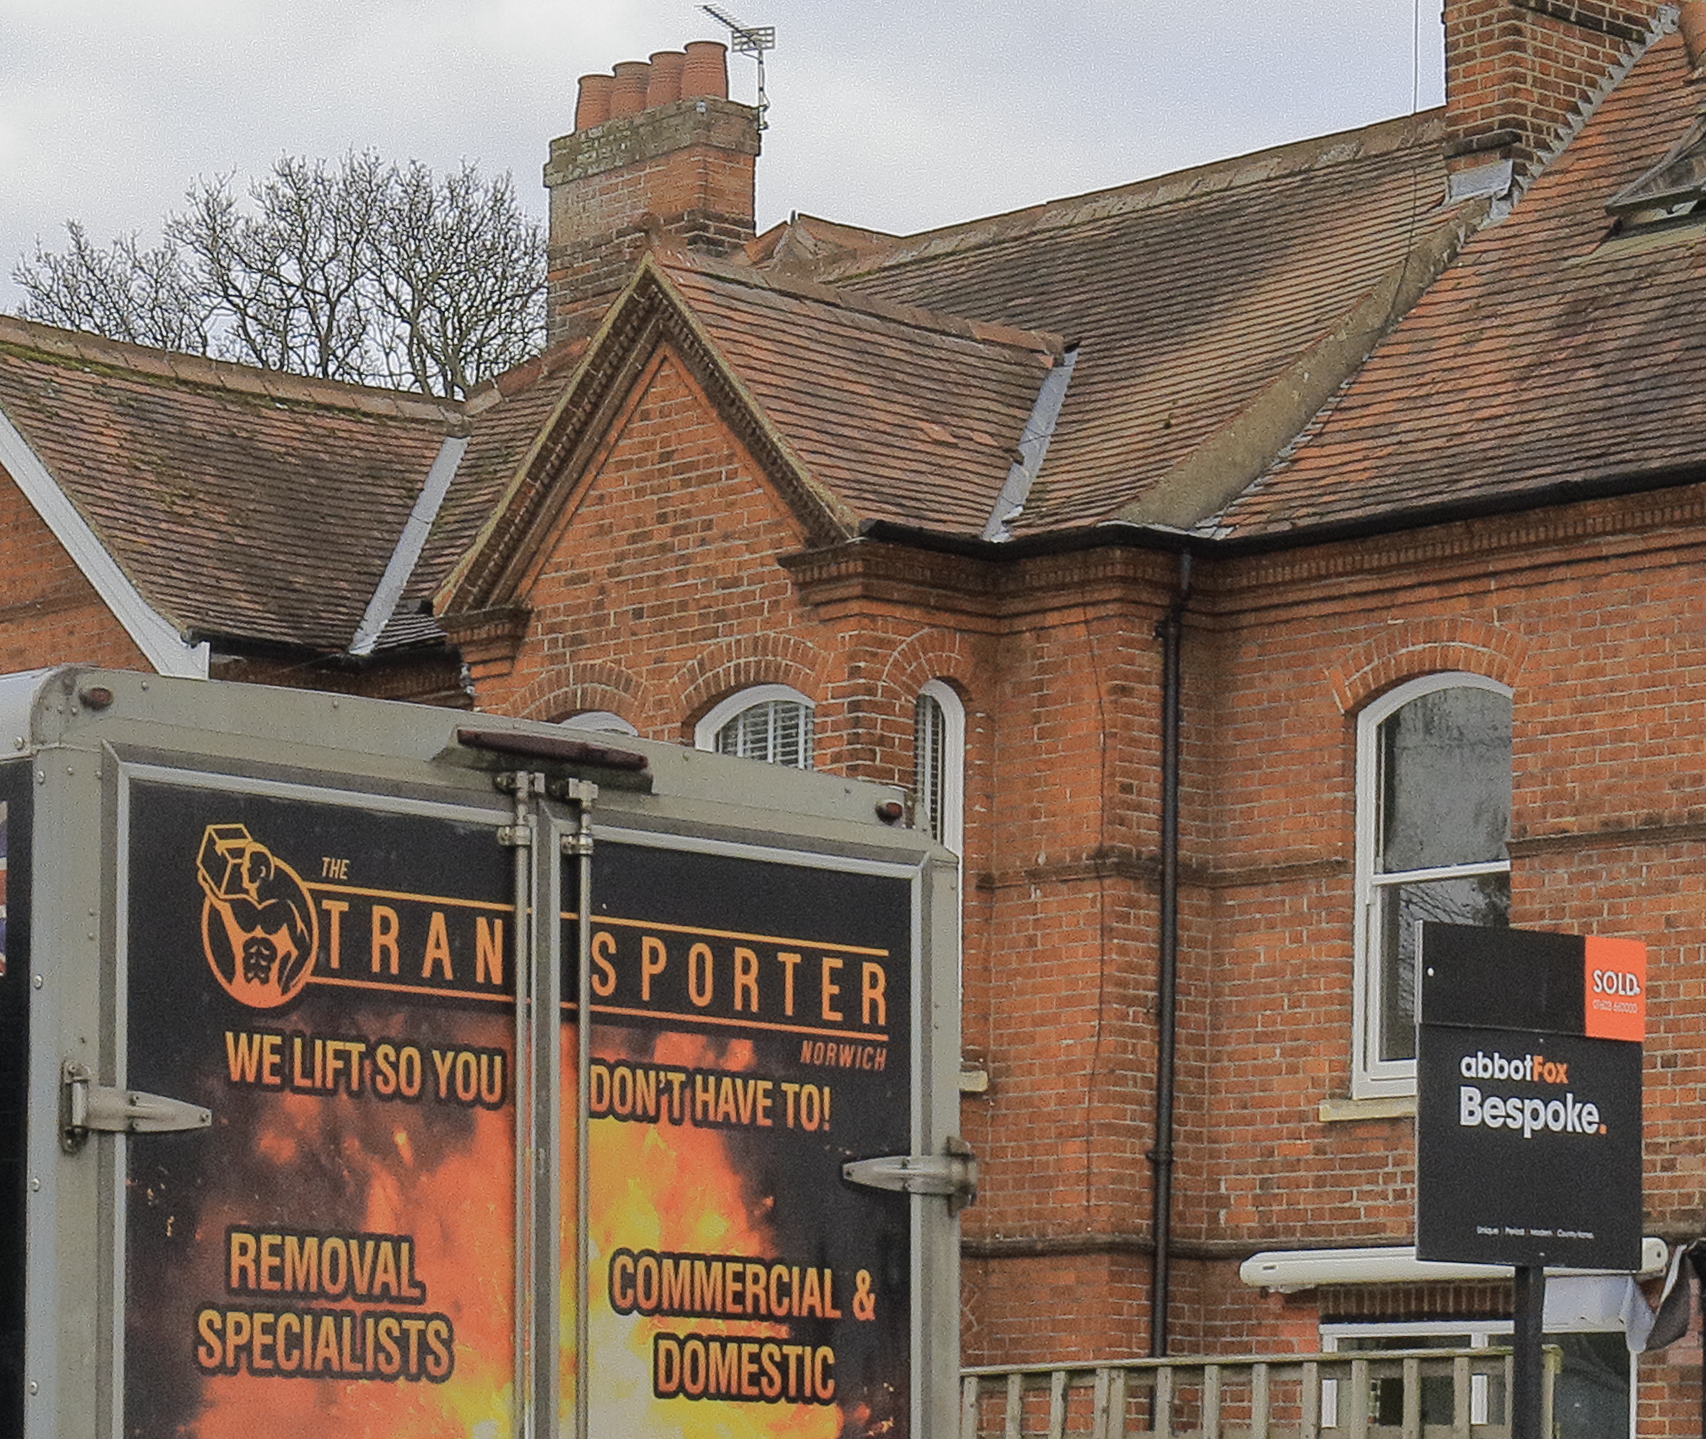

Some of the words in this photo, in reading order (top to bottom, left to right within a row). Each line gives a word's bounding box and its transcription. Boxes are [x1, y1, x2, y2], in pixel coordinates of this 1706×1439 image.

[321, 856, 349, 881] THE
[226, 1031, 283, 1084] WE
[294, 1036, 366, 1091] LIFT
[376, 1043, 421, 1098] SO
[434, 1049, 504, 1105] YOU
[590, 1064, 689, 1121] DON'T
[694, 1073, 772, 1129] HAVE
[781, 1080, 832, 1133] TO!
[800, 1040, 887, 1072] NORWICH
[1460, 1052, 1569, 1084] abbotFox
[1460, 1086, 1607, 1139] Bespoke.
[229, 1234, 422, 1301] REMOVAL
[611, 1252, 841, 1320] COMMERCIAL
[853, 1270, 876, 1321] &
[197, 1312, 452, 1378] SPECIALISTS
[656, 1336, 835, 1399] DOMESTIC
